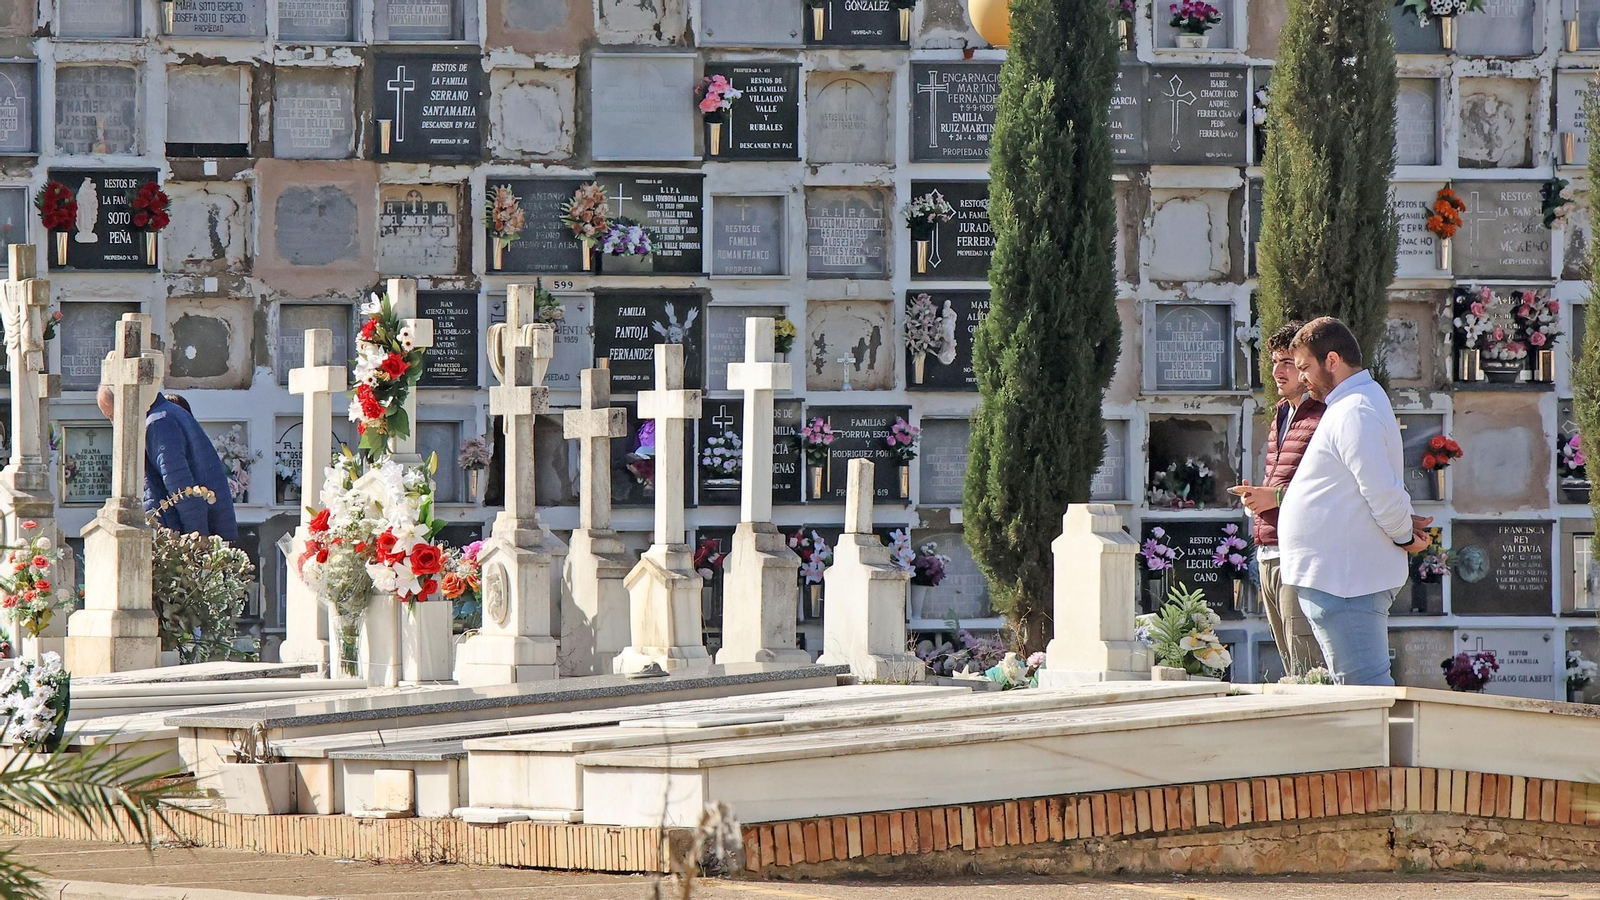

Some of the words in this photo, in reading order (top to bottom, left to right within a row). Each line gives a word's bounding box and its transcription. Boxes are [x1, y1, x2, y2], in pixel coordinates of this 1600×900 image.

[174, 1, 197, 12] MARIA
[199, 1, 217, 12] SOTO
[217, 1, 244, 12] ESPEJO
[844, 1, 891, 11] GONZALEZ
[172, 13, 198, 23] JOSEFA
[199, 13, 217, 23] SOTO
[219, 13, 246, 24] ESPEJO
[431, 63, 457, 72] RESTOS
[458, 63, 469, 72] DE
[431, 77, 441, 86] LA
[441, 77, 469, 86] FAMILIA
[1210, 80, 1228, 88] ISABEL
[957, 83, 996, 93] MARTIN
[430, 90, 469, 101] SERRANO
[1200, 90, 1223, 98] CHACON
[749, 95, 784, 103] VILLALON
[947, 94, 999, 104] FERNANDE
[1110, 96, 1137, 105] GARCIA
[422, 105, 477, 117] SANTAMARIA
[755, 105, 778, 113] VALLE
[952, 112, 984, 122] EMILIA
[1197, 110, 1217, 118] FERRER
[421, 121, 454, 129] DESCANSEN
[454, 121, 463, 129] EN
[749, 124, 784, 132] RUBIALES
[940, 123, 960, 133] RUIZ
[961, 123, 996, 133] MARTIN
[942, 148, 982, 156] PROPIEDAD
[104, 179, 128, 188] RESTOS
[102, 195, 112, 205] LA
[642, 194, 654, 202] SARA
[1500, 191, 1532, 201] RESTOS
[647, 210, 660, 218] JUSTO
[661, 210, 676, 218] VALLE
[676, 210, 693, 218] RIVERA
[958, 210, 967, 219] LA
[1498, 206, 1509, 217] LA
[107, 212, 130, 224] SOTO
[835, 218, 858, 229] MATEOS
[725, 225, 750, 233] RESTOS
[751, 225, 761, 233] DE
[109, 229, 132, 244] PEÑA
[729, 236, 758, 246] FAMILIA
[664, 242, 678, 250] VALLE
[717, 249, 742, 260] ROMAN
[742, 249, 770, 260] FRANCO
[553, 280, 574, 290] 599
[618, 307, 646, 316] FAMILIA
[614, 327, 649, 341] PANTOJA
[609, 348, 655, 360] FERNANDEZ
[783, 409, 793, 418] DE
[851, 419, 887, 427] FAMILIAS
[841, 430, 871, 439] PORRUA
[865, 440, 870, 448] Y
[832, 449, 874, 458] RODRIGUEZ
[1498, 526, 1545, 534] FRANCISCA
[1189, 536, 1213, 544] RESTOS
[1513, 535, 1530, 544] REY
[1187, 548, 1197, 556] LA
[1501, 544, 1542, 553] VALDIVIA
[1186, 559, 1221, 569] LECHU
[1193, 572, 1218, 582] CANO
[1517, 674, 1553, 684] GILABERT
